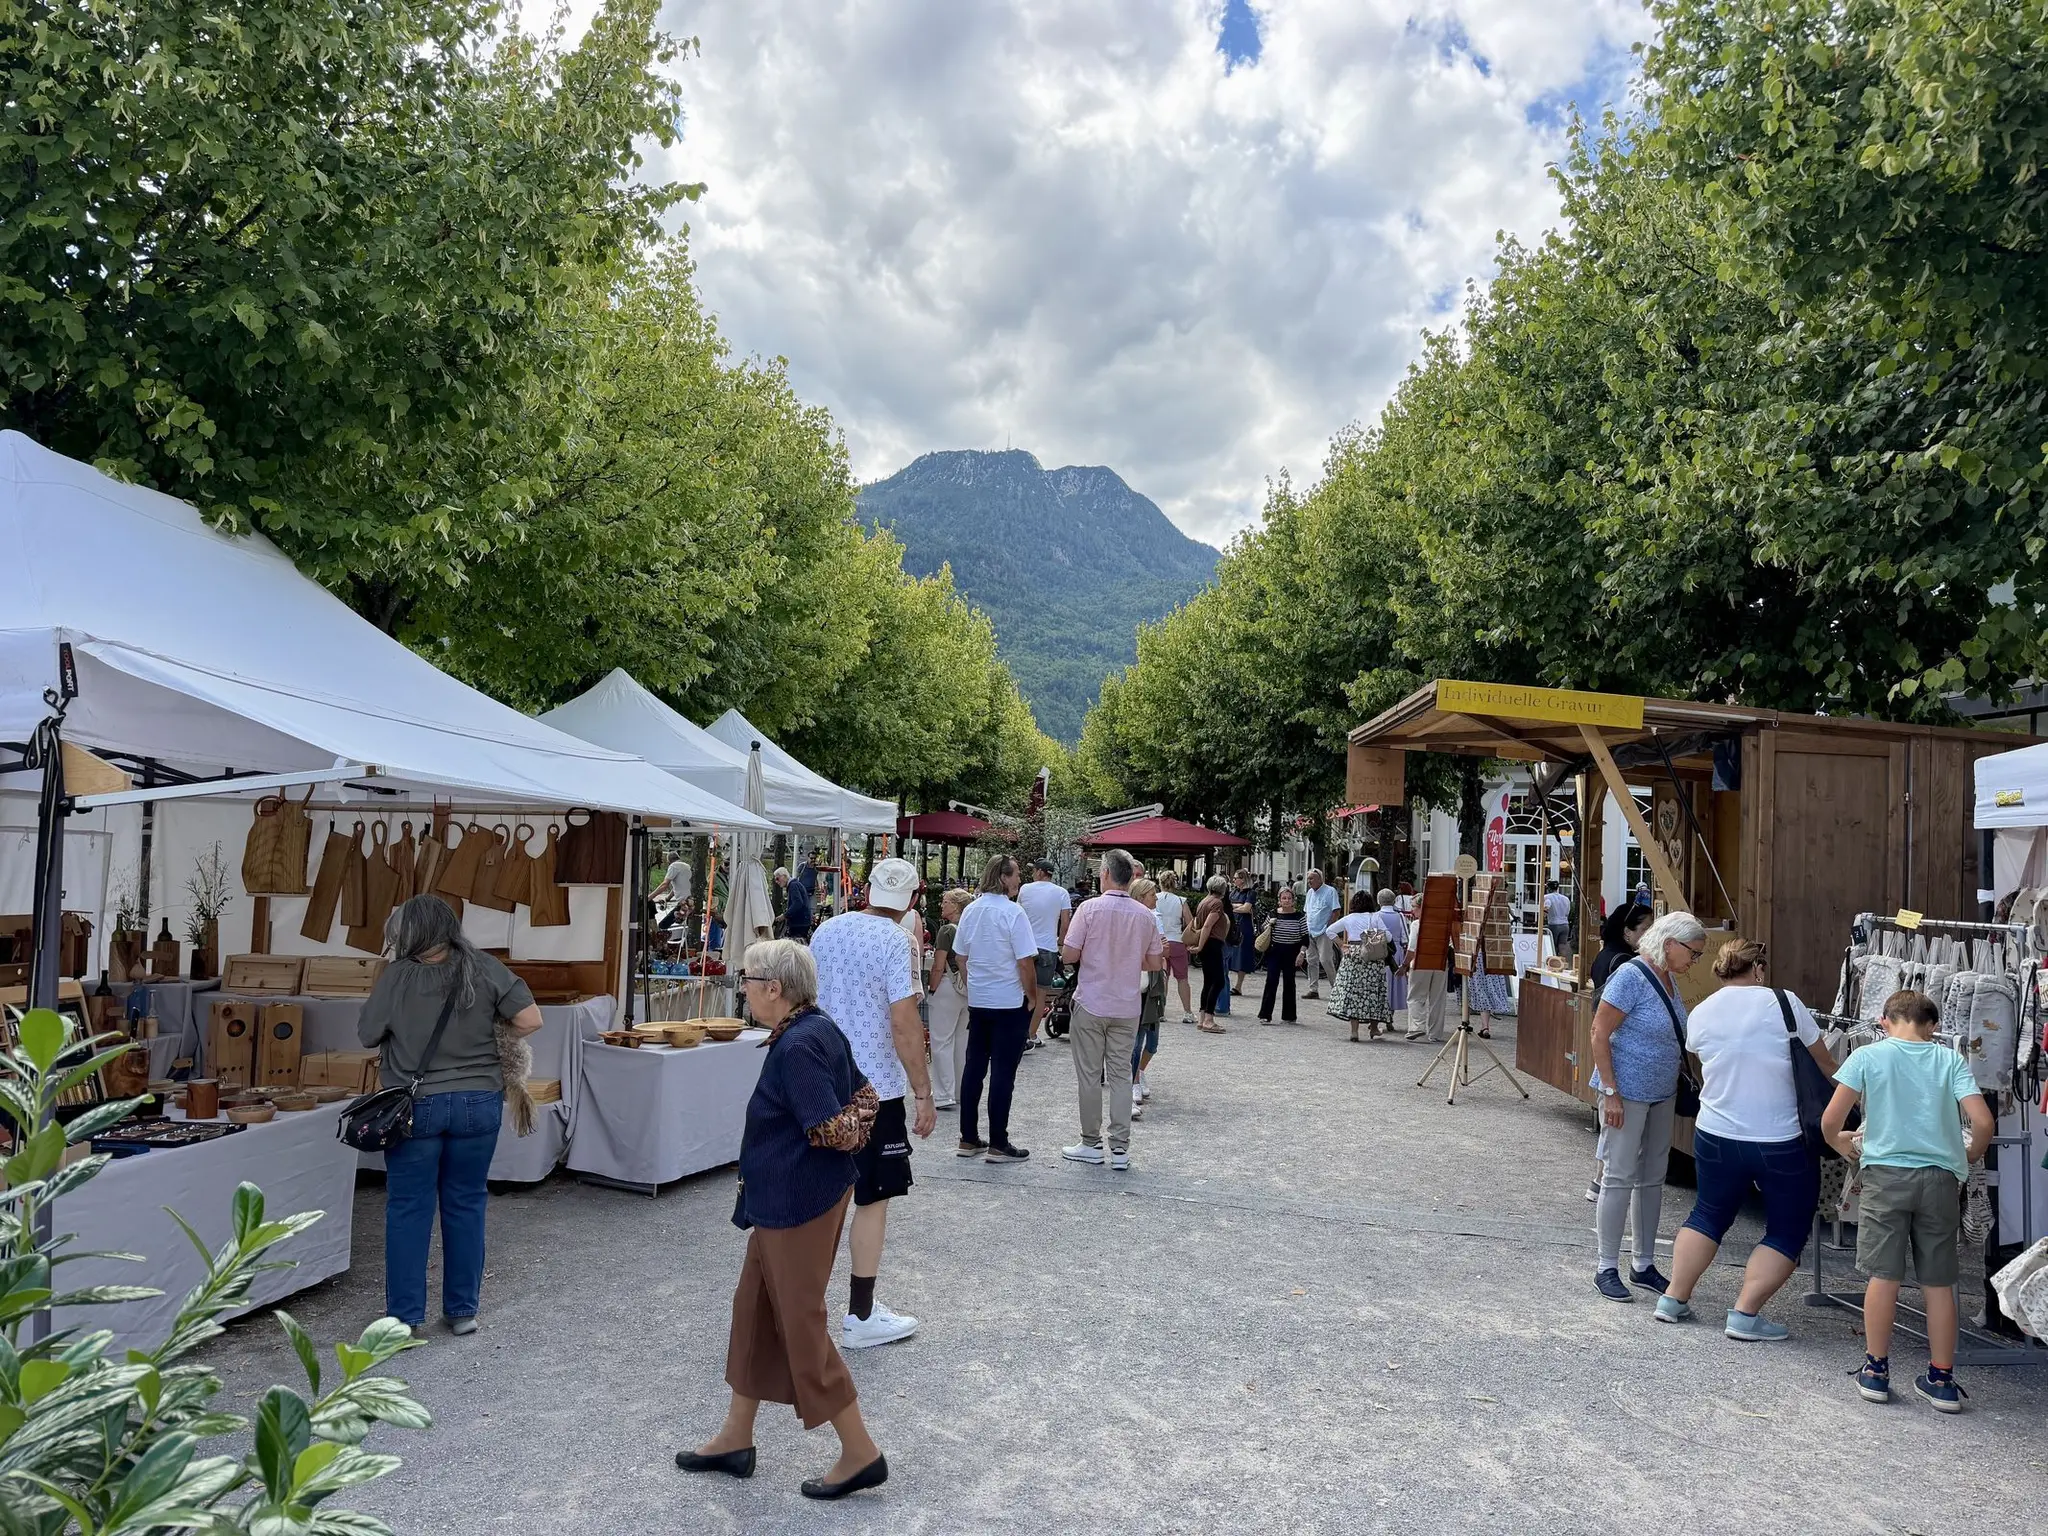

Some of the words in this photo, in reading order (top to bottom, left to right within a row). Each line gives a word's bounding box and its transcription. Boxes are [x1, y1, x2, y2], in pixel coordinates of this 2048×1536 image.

[1443, 686, 1542, 708] Individuelle
[1547, 695, 1605, 713] Gravur
[1351, 773, 1400, 786] Gravur
